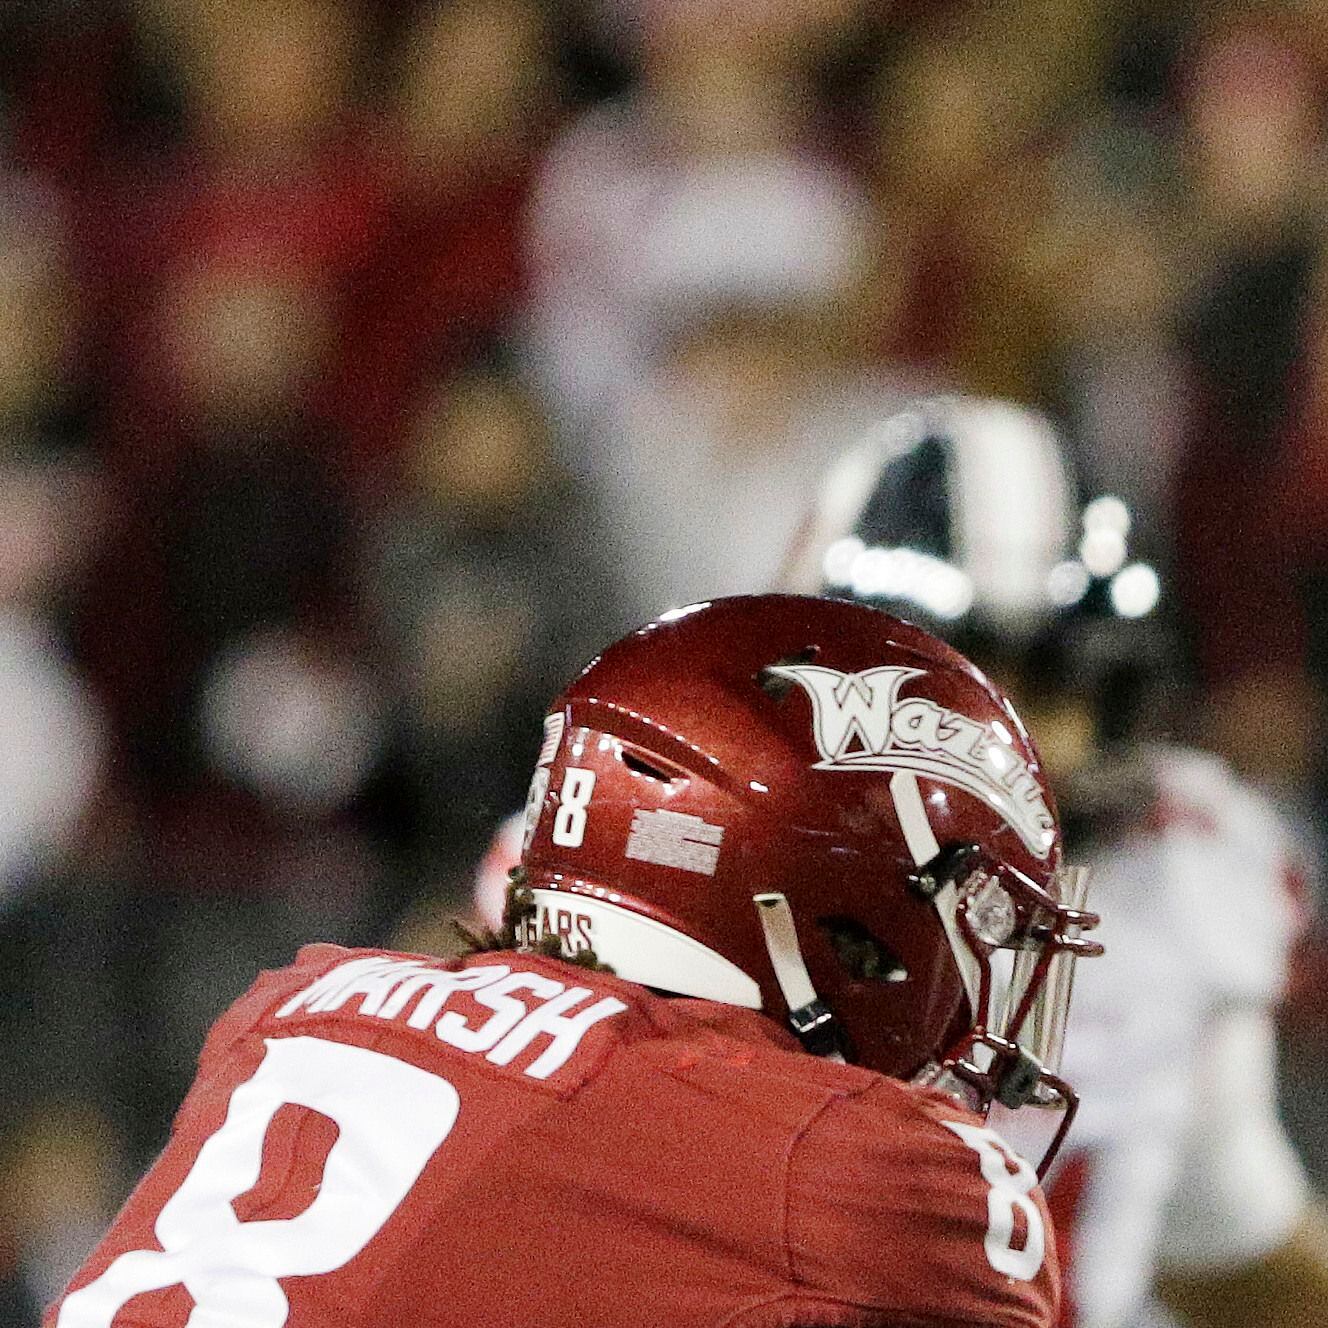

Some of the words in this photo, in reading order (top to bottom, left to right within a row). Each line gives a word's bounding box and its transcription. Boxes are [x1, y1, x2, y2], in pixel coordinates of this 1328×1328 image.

[552, 767, 597, 848] 8
[275, 957, 629, 1080] MARSH
[940, 1117, 1046, 1282] 8
